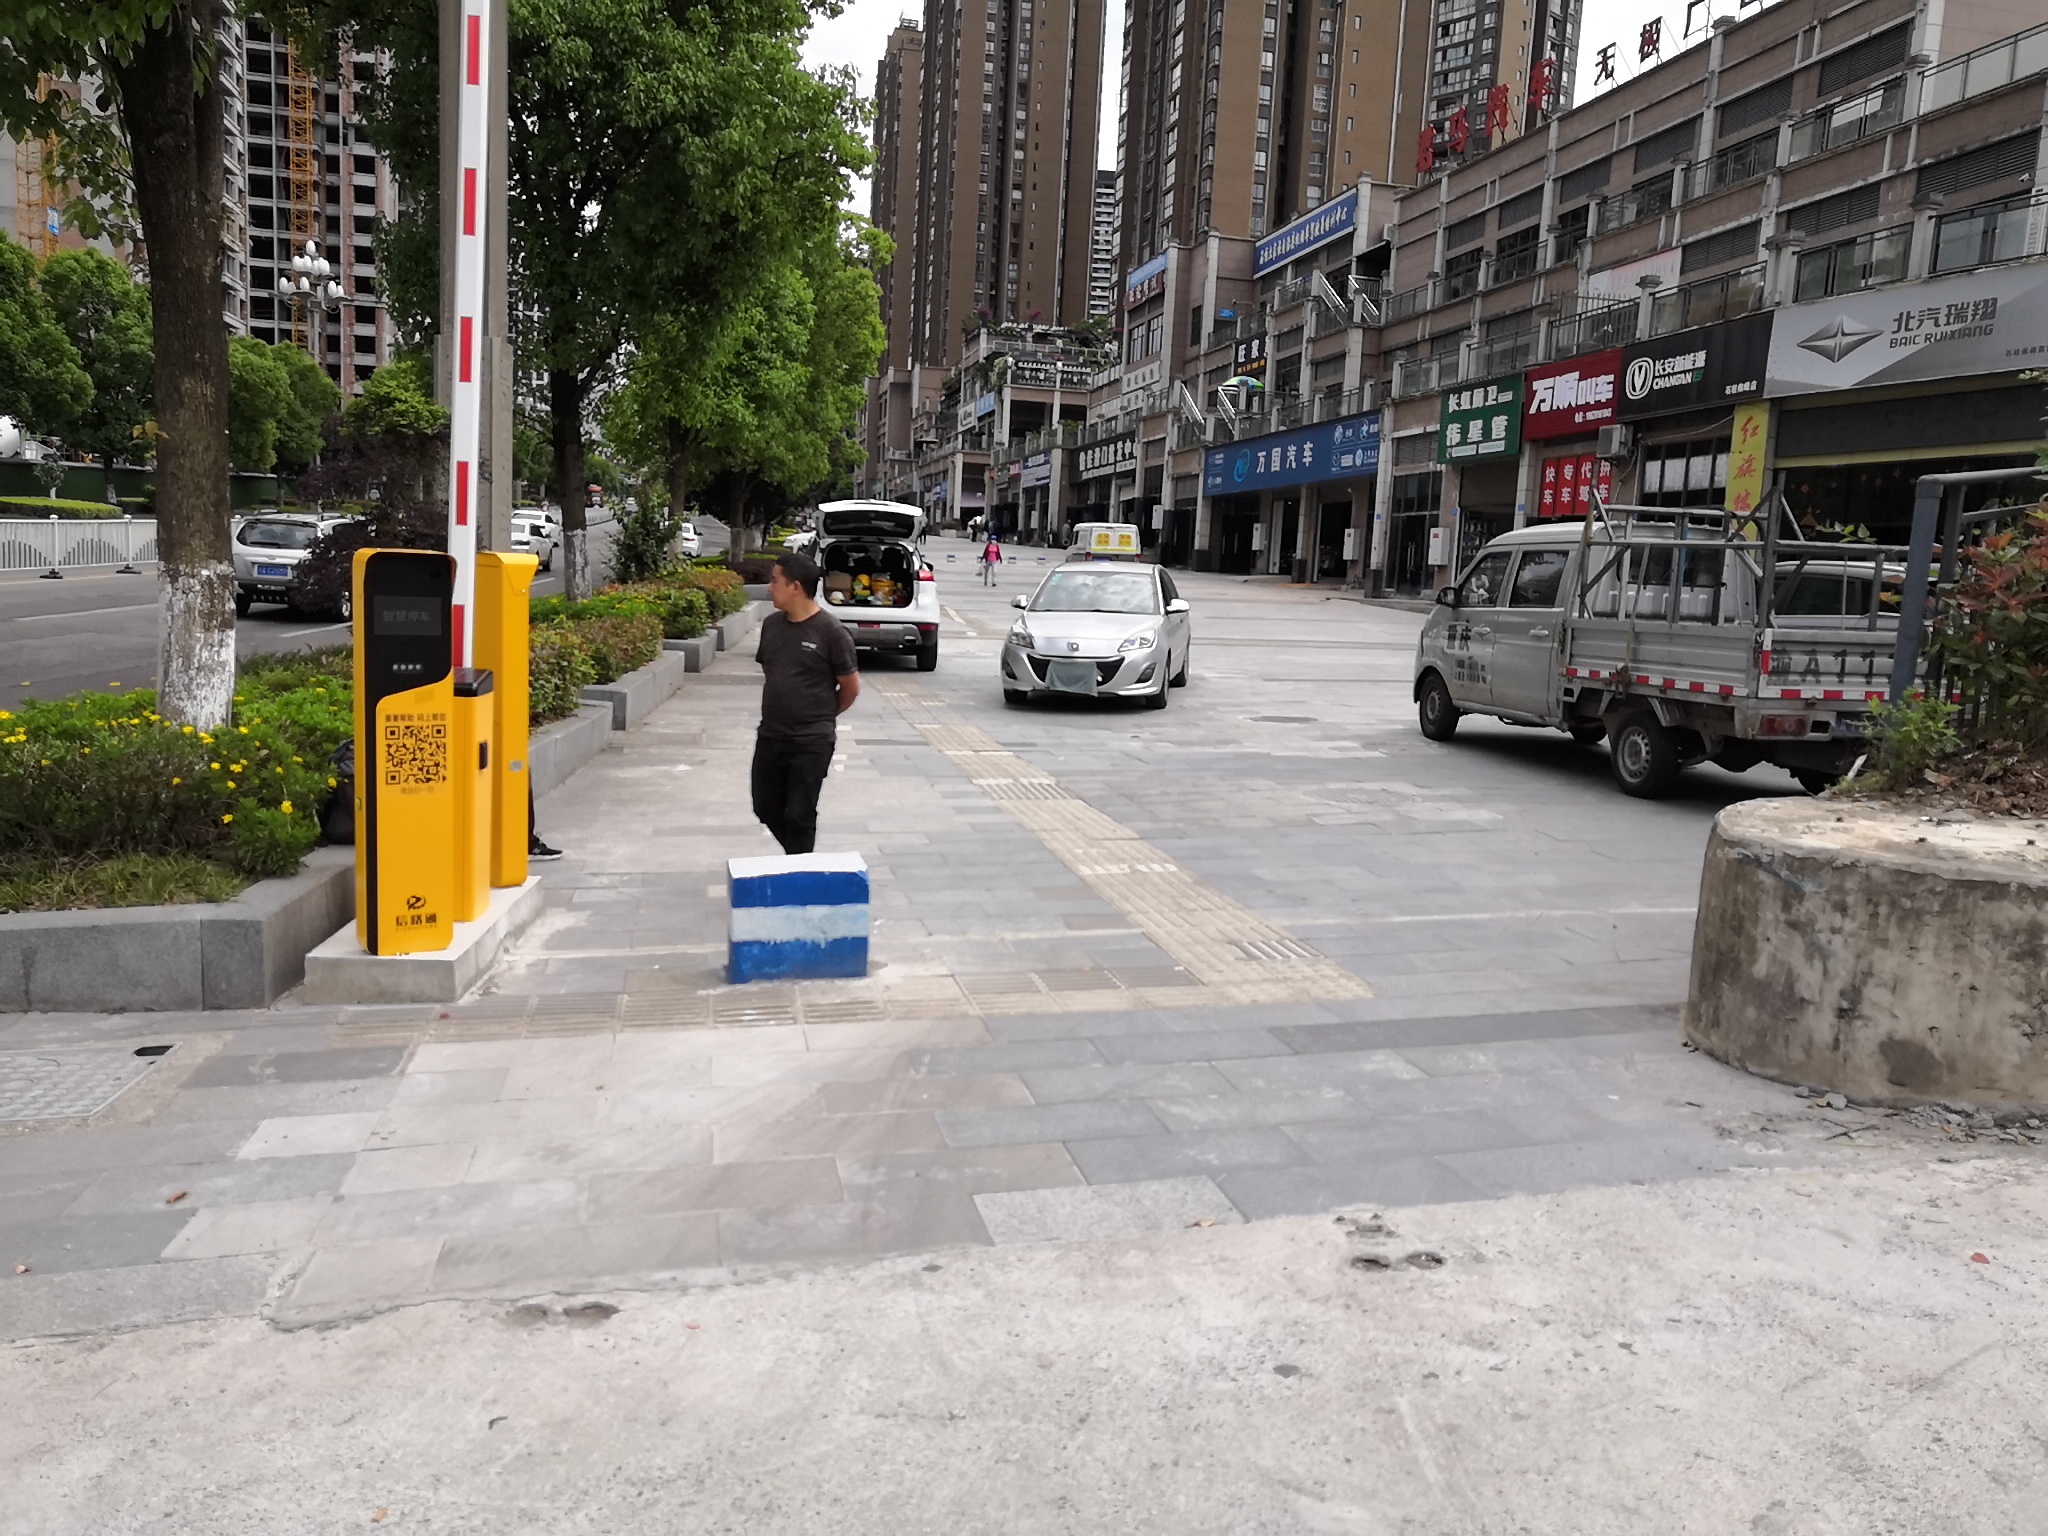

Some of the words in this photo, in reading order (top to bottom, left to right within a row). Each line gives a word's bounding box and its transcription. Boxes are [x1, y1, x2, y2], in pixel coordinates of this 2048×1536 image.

[1891, 297, 1998, 335] 北汽瑞翔
[1889, 333, 1922, 349] BAIC
[1924, 323, 1994, 345] RUIXIANG
[1655, 350, 1707, 377] 长安新能源
[1529, 371, 1615, 415] 万顺叫车
[1653, 372, 1692, 390] CHANGAN
[1448, 385, 1498, 413] 长虹厨卫
[1446, 415, 1508, 446] 伟星管
[1256, 441, 1314, 474] 万国汽车
[1543, 466, 1555, 505] 快车
[1561, 463, 1574, 503] 专车
[1579, 461, 1592, 502] 代驾
[1599, 459, 1611, 500] 拼车
[396, 913, 437, 927] 信路通
